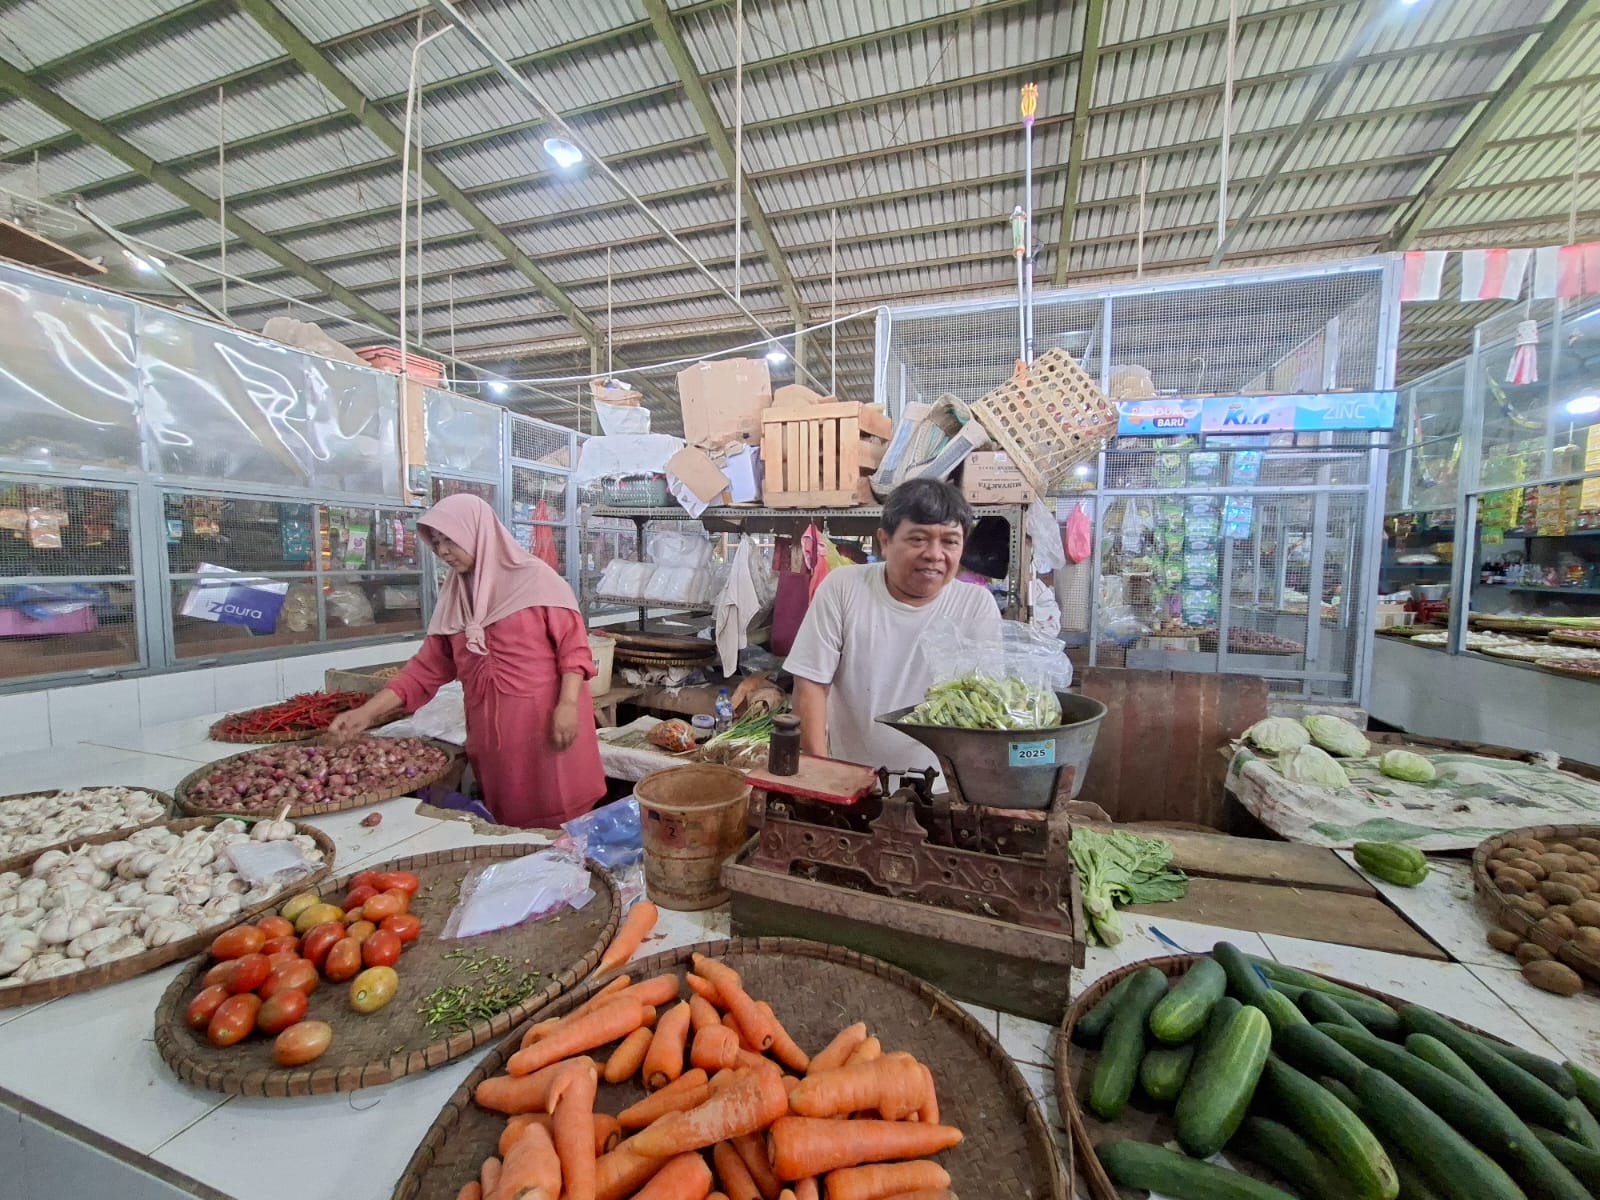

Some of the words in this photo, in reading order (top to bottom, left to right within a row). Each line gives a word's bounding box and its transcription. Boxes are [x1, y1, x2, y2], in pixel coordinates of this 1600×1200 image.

[1323, 403, 1368, 420] ZINC
[1157, 418, 1185, 427] BARU
[1019, 750, 1046, 758] 2025
